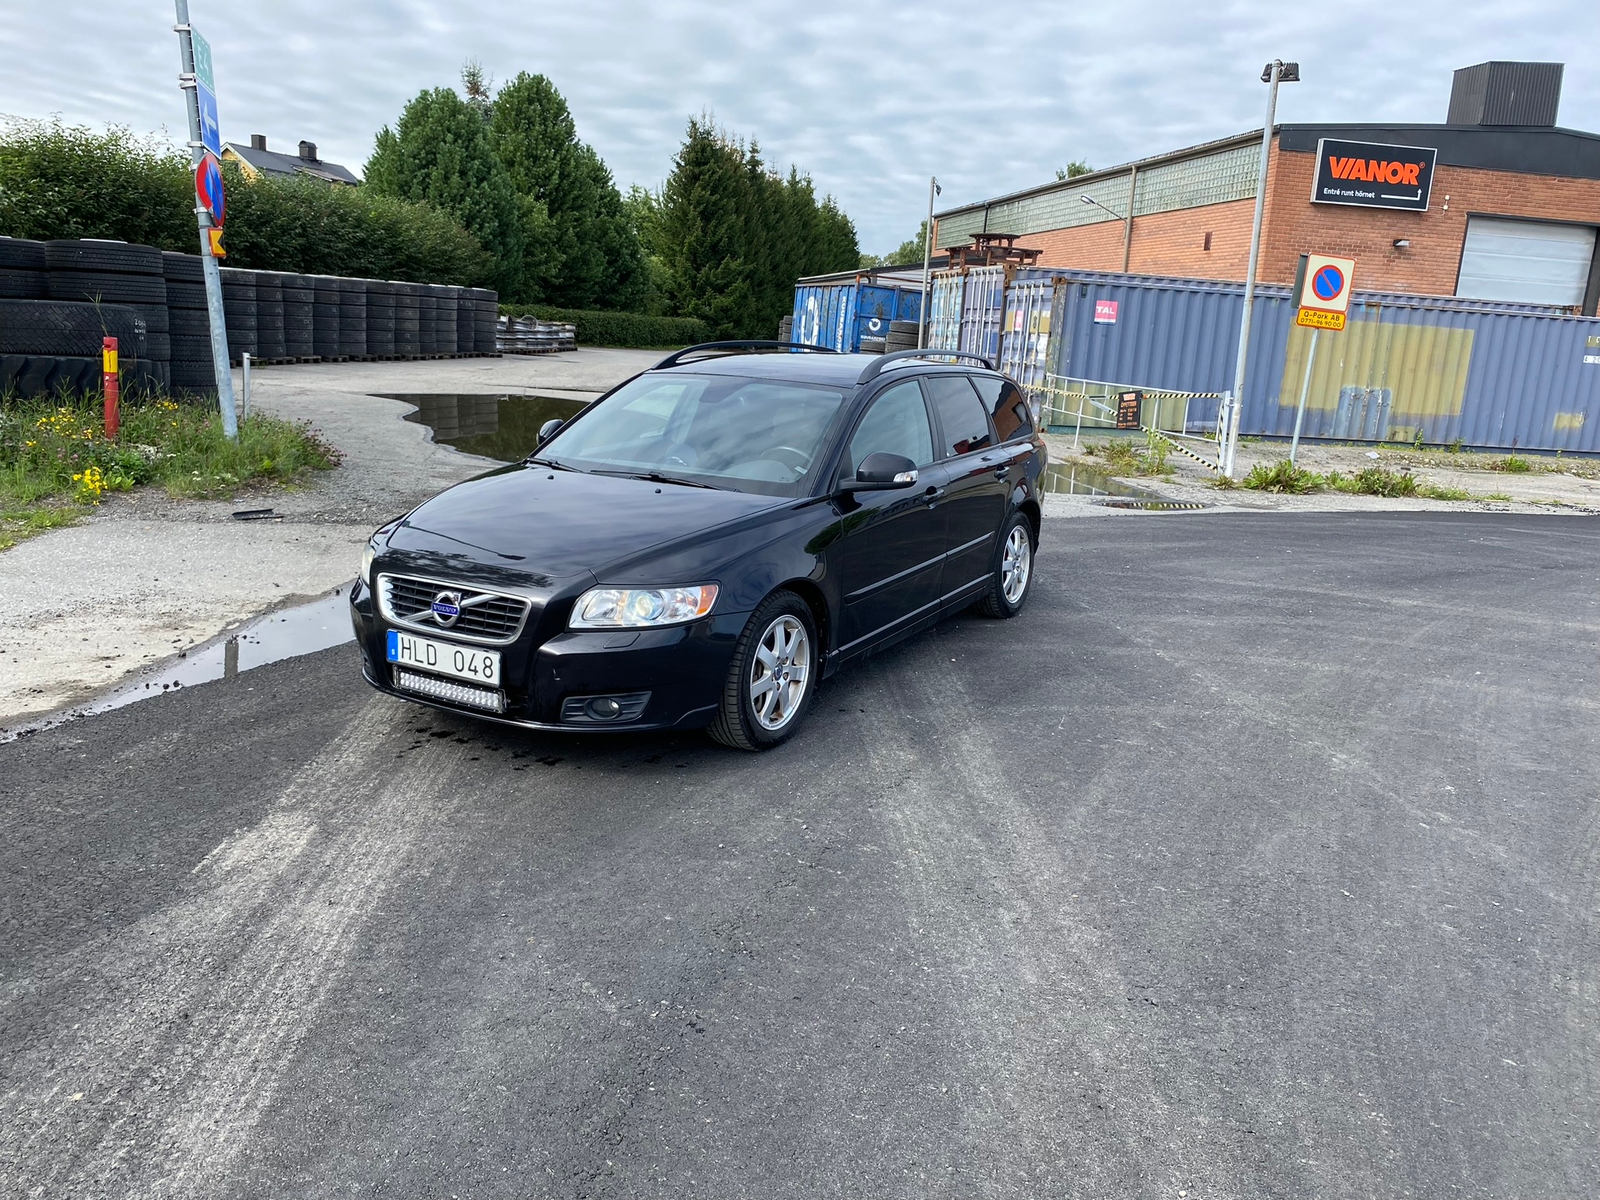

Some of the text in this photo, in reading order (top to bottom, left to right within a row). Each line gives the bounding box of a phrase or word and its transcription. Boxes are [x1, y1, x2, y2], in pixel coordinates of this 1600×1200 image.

[197, 44, 210, 75] E4
[1329, 156, 1419, 185] VIANOR
[1323, 187, 1375, 198] Entré runt hörnet
[1096, 306, 1115, 314] TAL
[1304, 311, 1328, 320] Q-Park
[1300, 318, 1323, 326] 0771-96
[433, 604, 457, 613] VOLVO
[401, 637, 437, 666] HLD
[454, 650, 493, 678] 048
